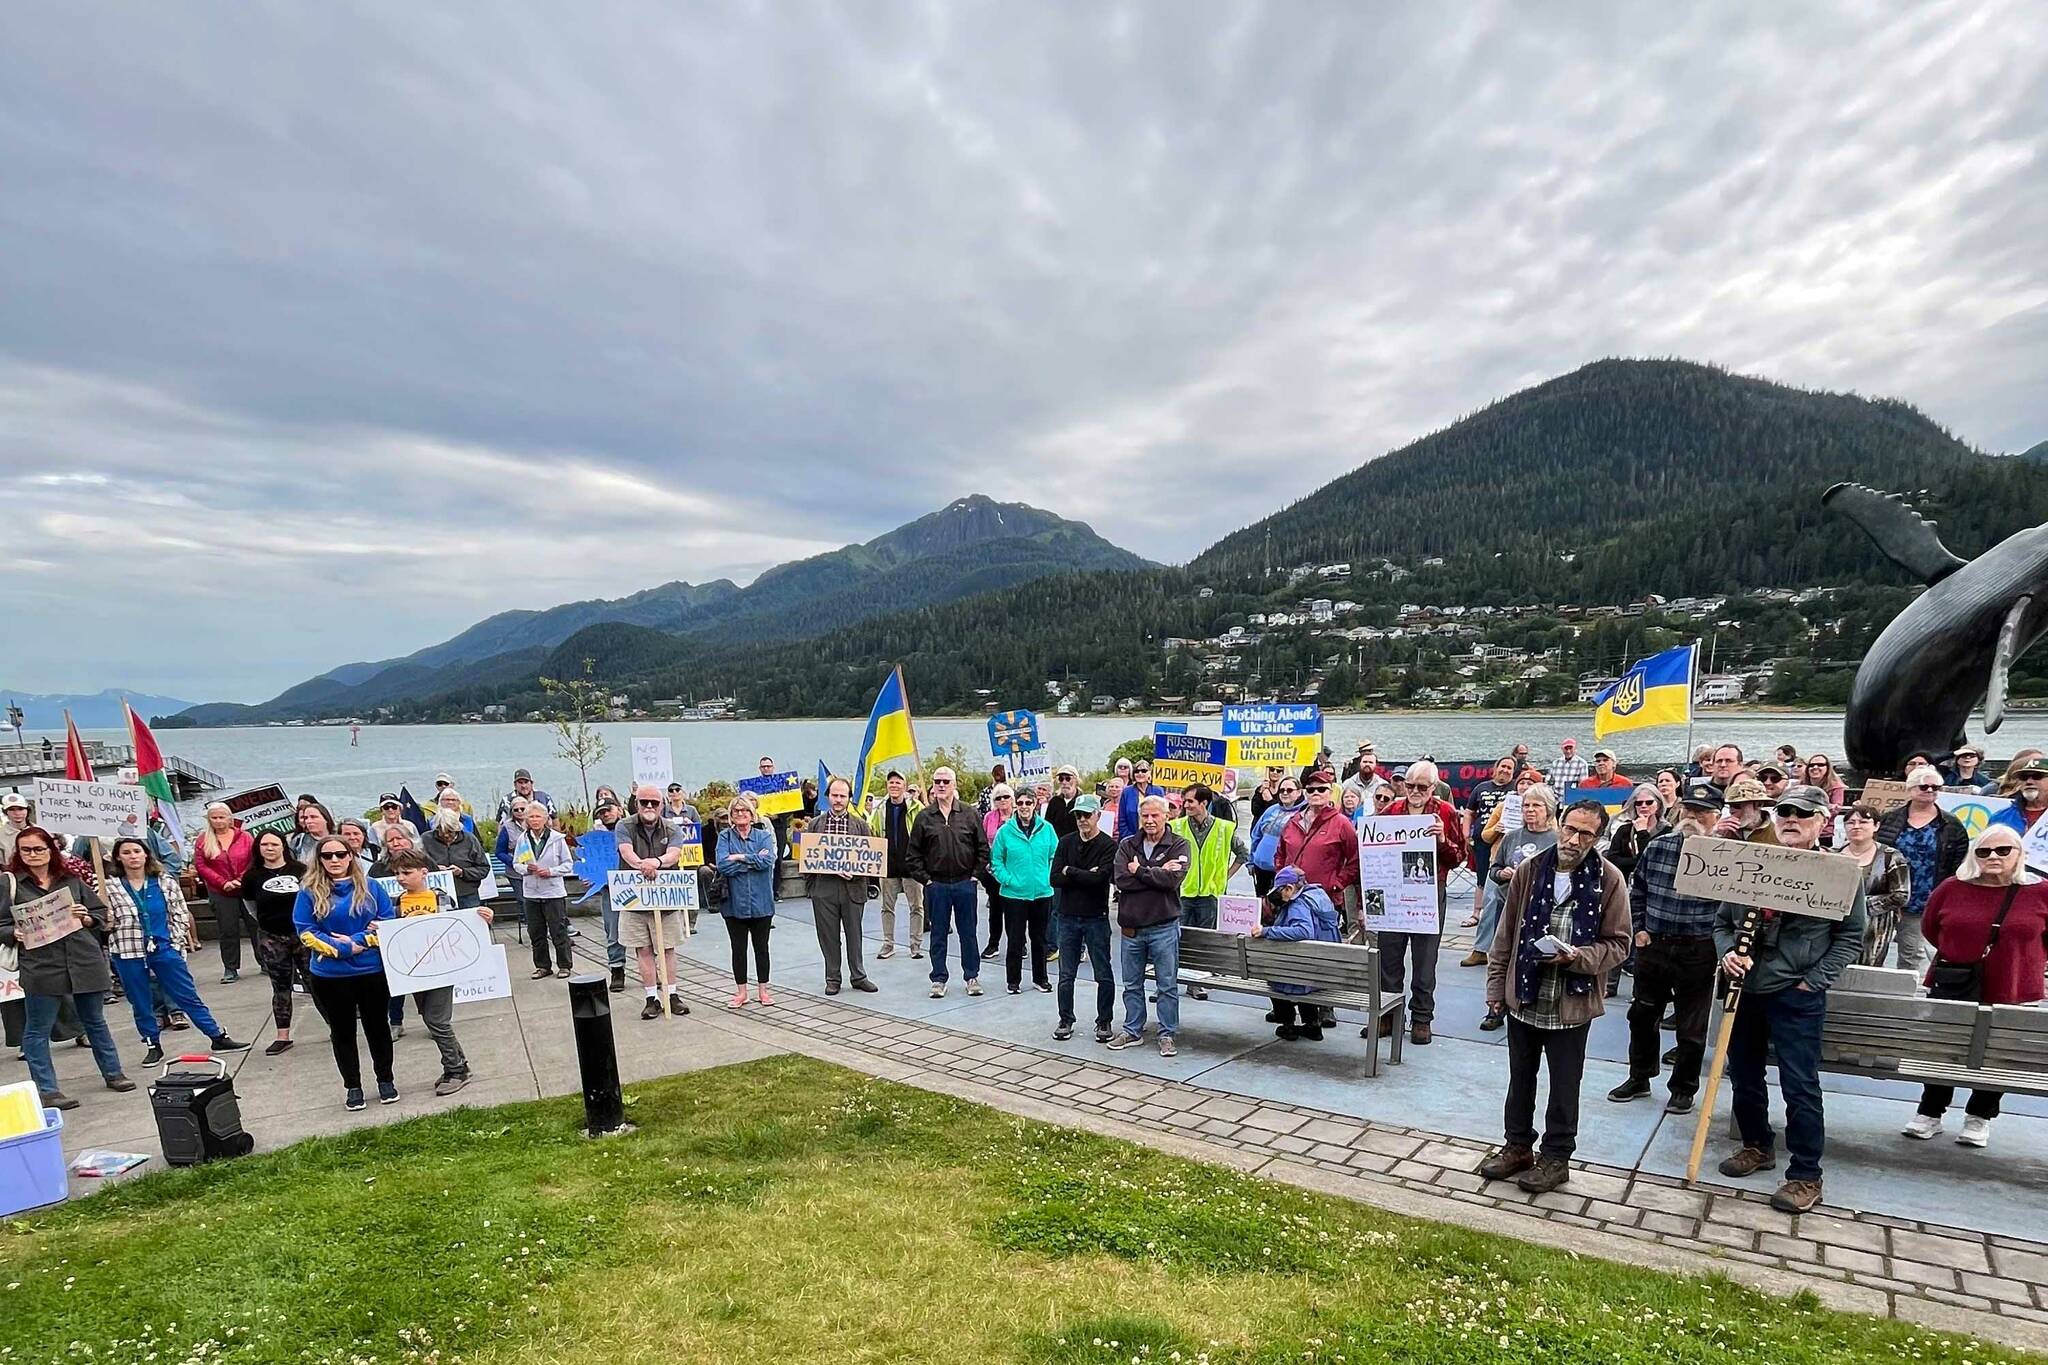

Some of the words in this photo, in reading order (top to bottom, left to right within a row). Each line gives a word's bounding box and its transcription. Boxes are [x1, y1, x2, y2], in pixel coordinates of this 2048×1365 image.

[1227, 708, 1276, 722] Nothing
[1277, 706, 1314, 721] About
[1240, 722, 1294, 733] Ukraine
[1166, 736, 1211, 750] RUSSIAN
[1240, 737, 1294, 749] without
[1166, 749, 1212, 763] WARSHIP
[1240, 747, 1298, 763] Ukraine!
[39, 780, 81, 796] PUTIN
[88, 785, 105, 797] GO
[109, 789, 141, 801] HOME
[46, 797, 71, 808] TAKE
[99, 802, 137, 813] ORANGE
[230, 789, 279, 810] UNEAU
[244, 808, 272, 823] STANDS
[818, 836, 870, 849] ALASKA
[1711, 840, 1748, 857] 47
[806, 848, 820, 859] IS
[824, 848, 852, 860] NOT
[855, 849, 883, 863] YOUR
[804, 859, 882, 874] WAREHOUSE!
[1683, 852, 1729, 877] Due
[1735, 861, 1814, 891] Process
[660, 873, 695, 885] STANDS
[611, 887, 637, 906] WITH
[640, 886, 695, 907] UKRAINE
[398, 929, 471, 969] WAR
